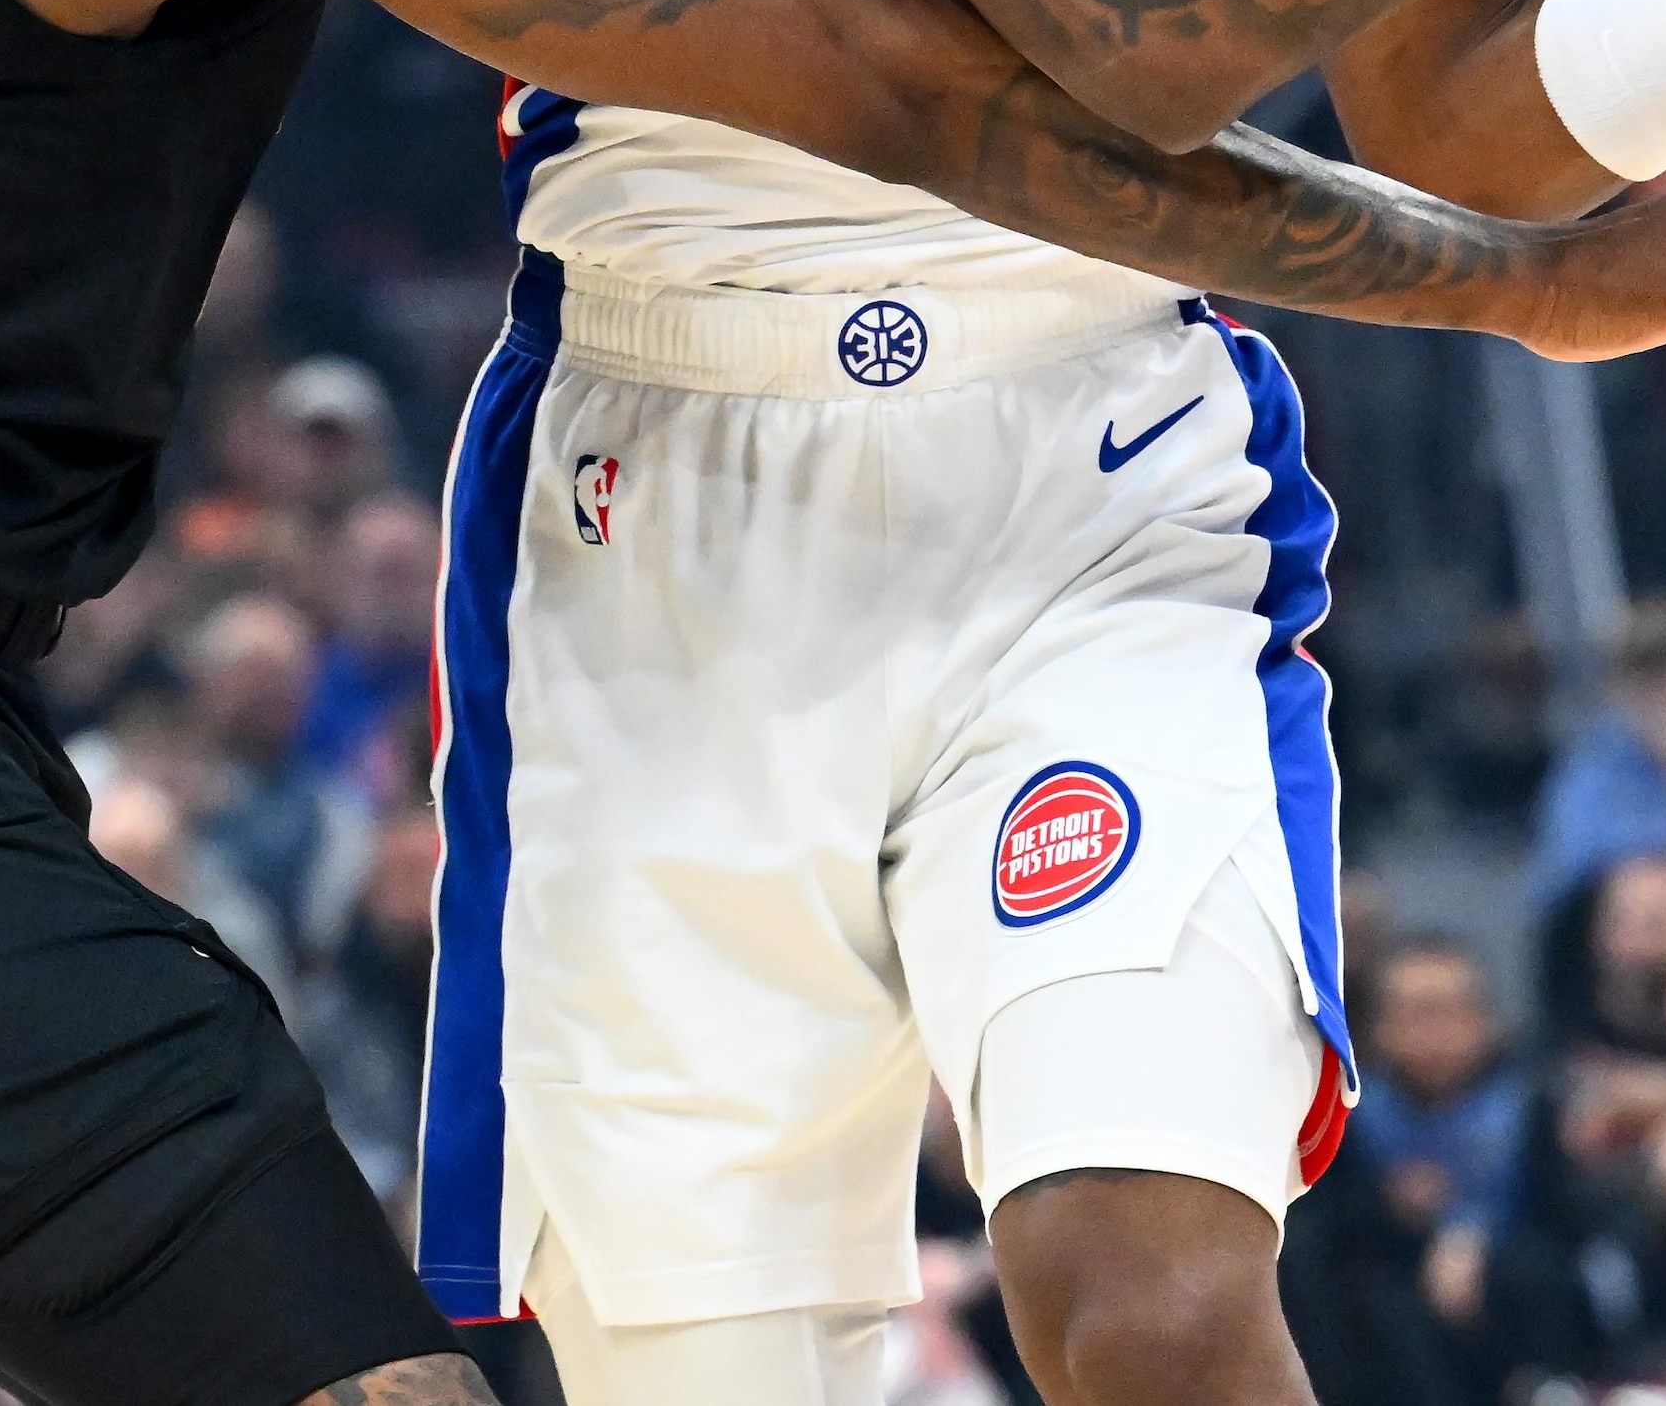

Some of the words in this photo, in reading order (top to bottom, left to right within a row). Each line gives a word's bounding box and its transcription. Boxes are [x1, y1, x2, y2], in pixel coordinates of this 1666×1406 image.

[844, 316, 922, 374] 313
[1008, 833, 1105, 886] PISTONS
[1010, 808, 1106, 858] DETROIT
